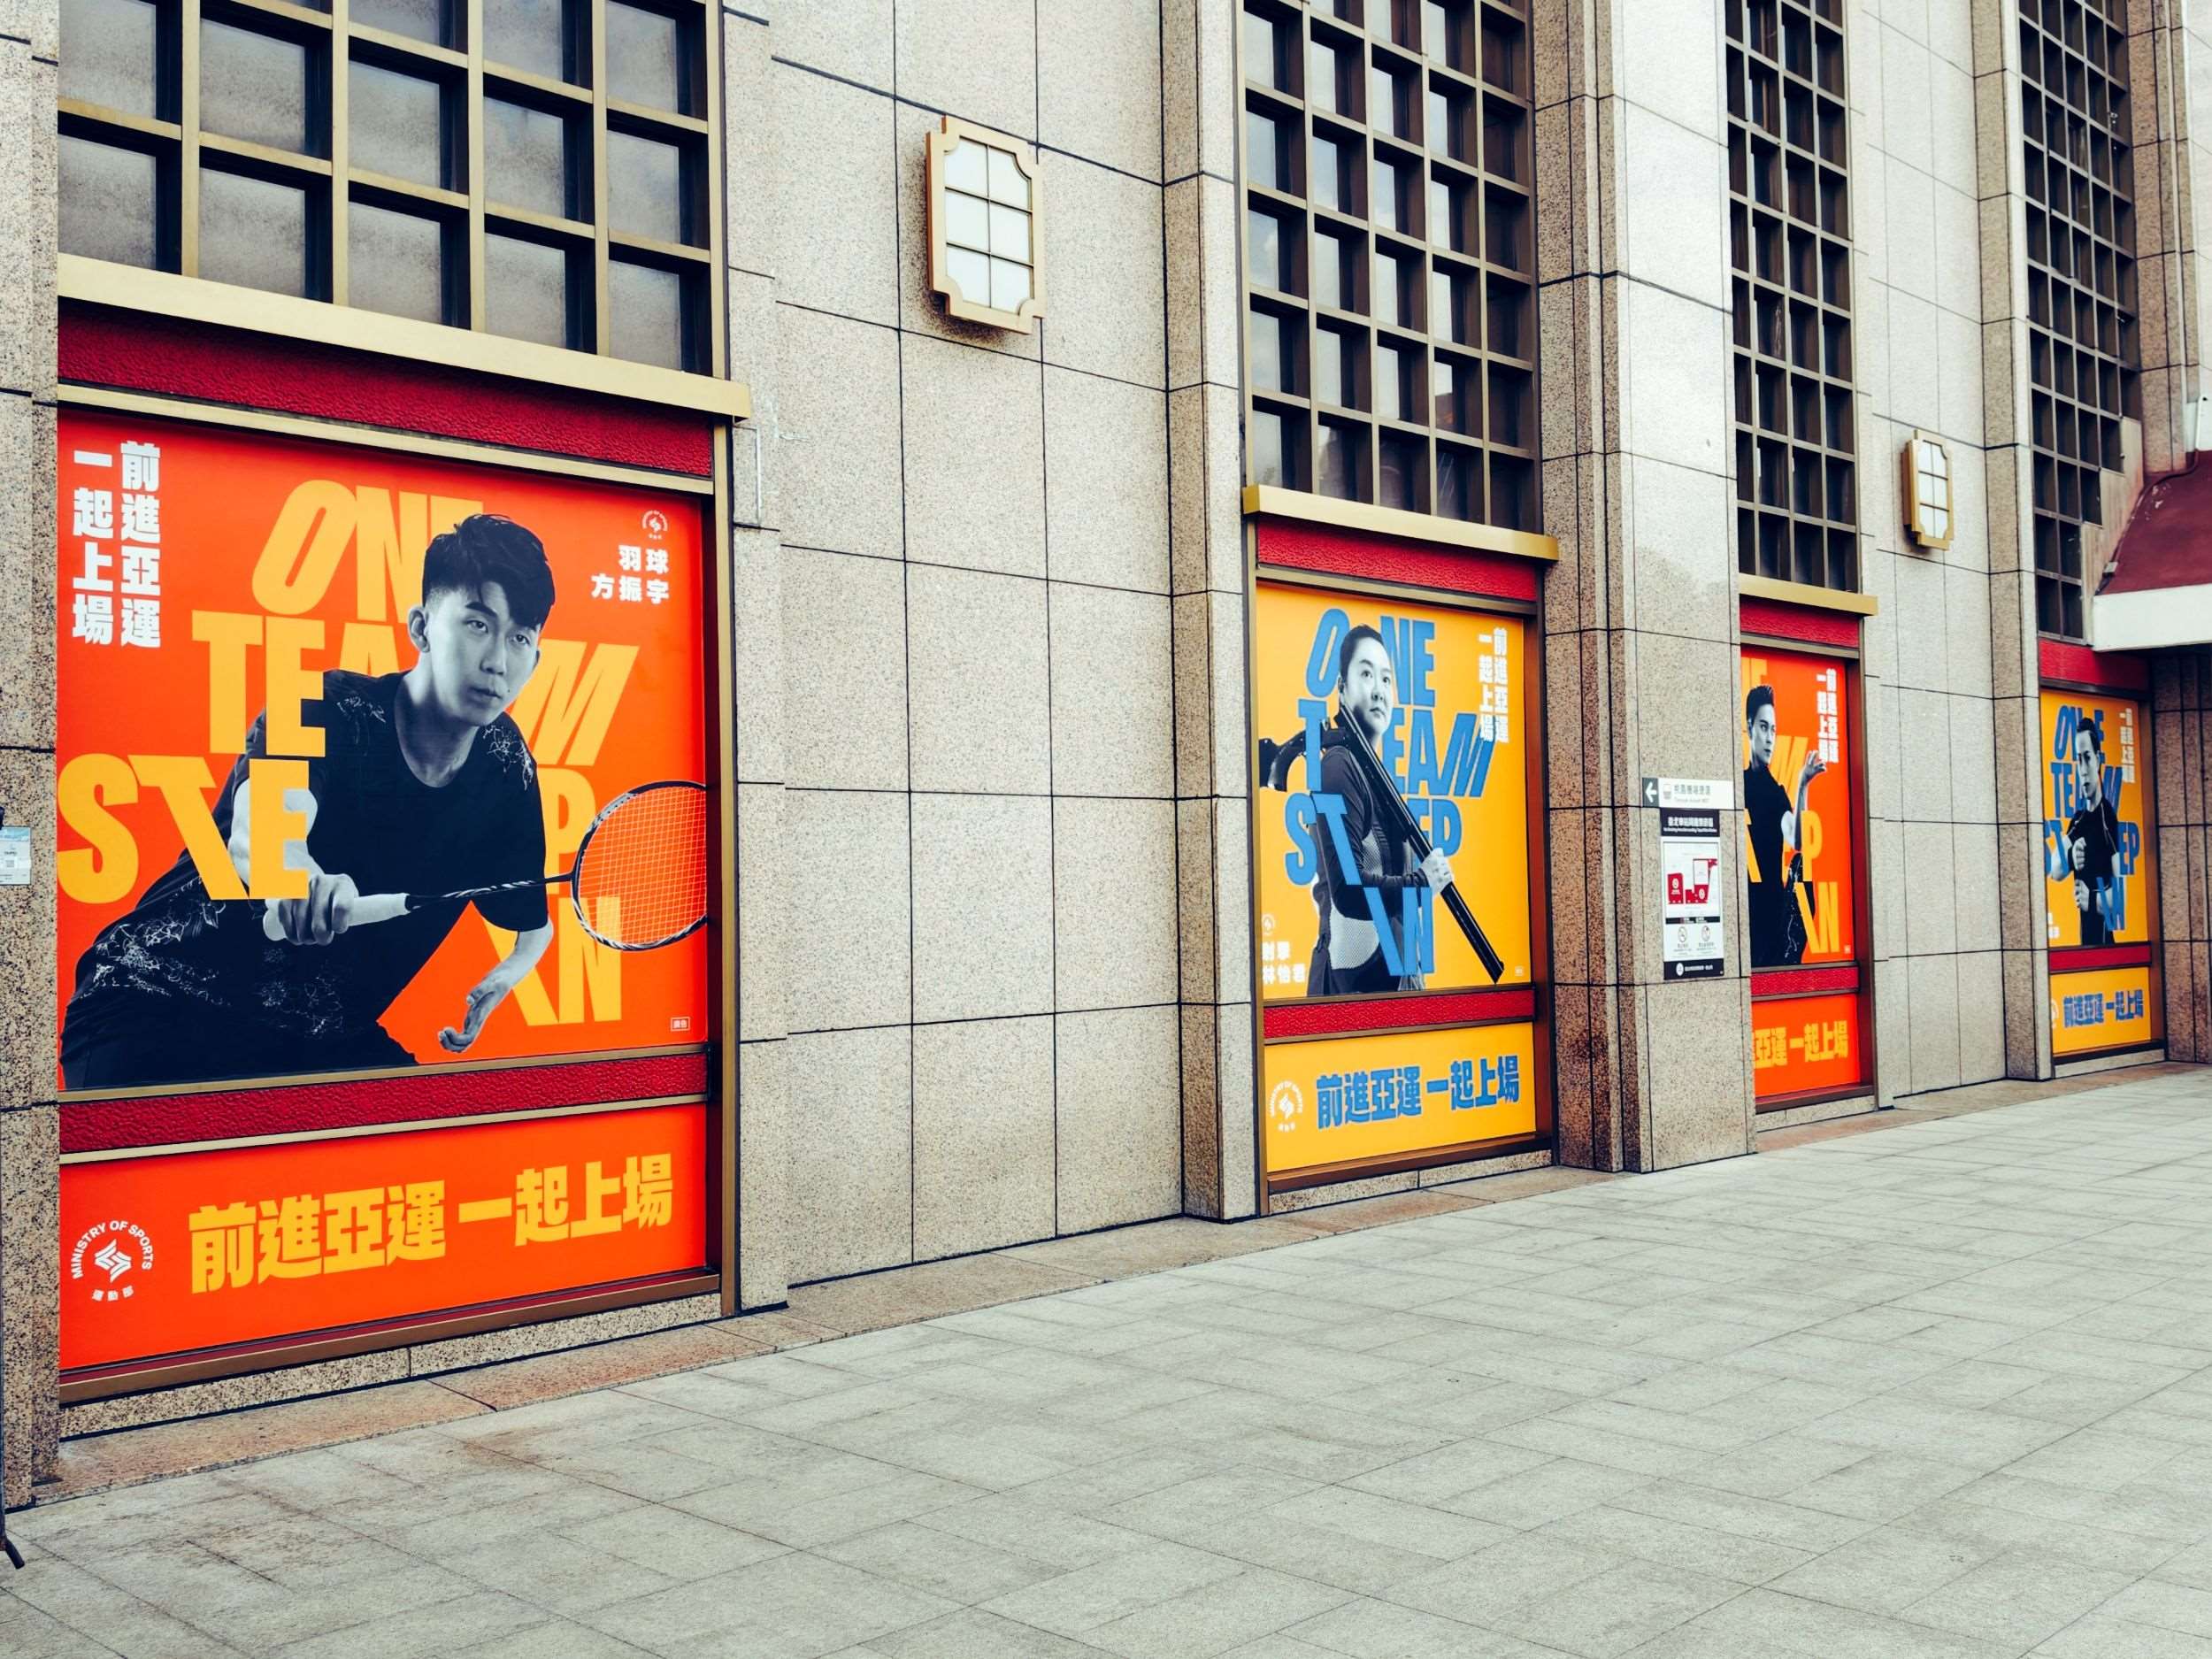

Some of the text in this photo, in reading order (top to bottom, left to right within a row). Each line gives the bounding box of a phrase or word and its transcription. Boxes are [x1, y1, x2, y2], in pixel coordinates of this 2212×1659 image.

[73, 450, 113, 645] 一起上場
[120, 441, 161, 648] 前進亞運
[251, 480, 485, 624] ON
[591, 572, 670, 604] 方振宇
[618, 544, 670, 574] 羽球
[1316, 1065, 1422, 1130] 前進亞運
[1426, 1055, 1519, 1111] 一起上場
[71, 1220, 153, 1279] MINISTRY OF SPORTS
[188, 1153, 673, 1294] 前進亞運 一起上場
